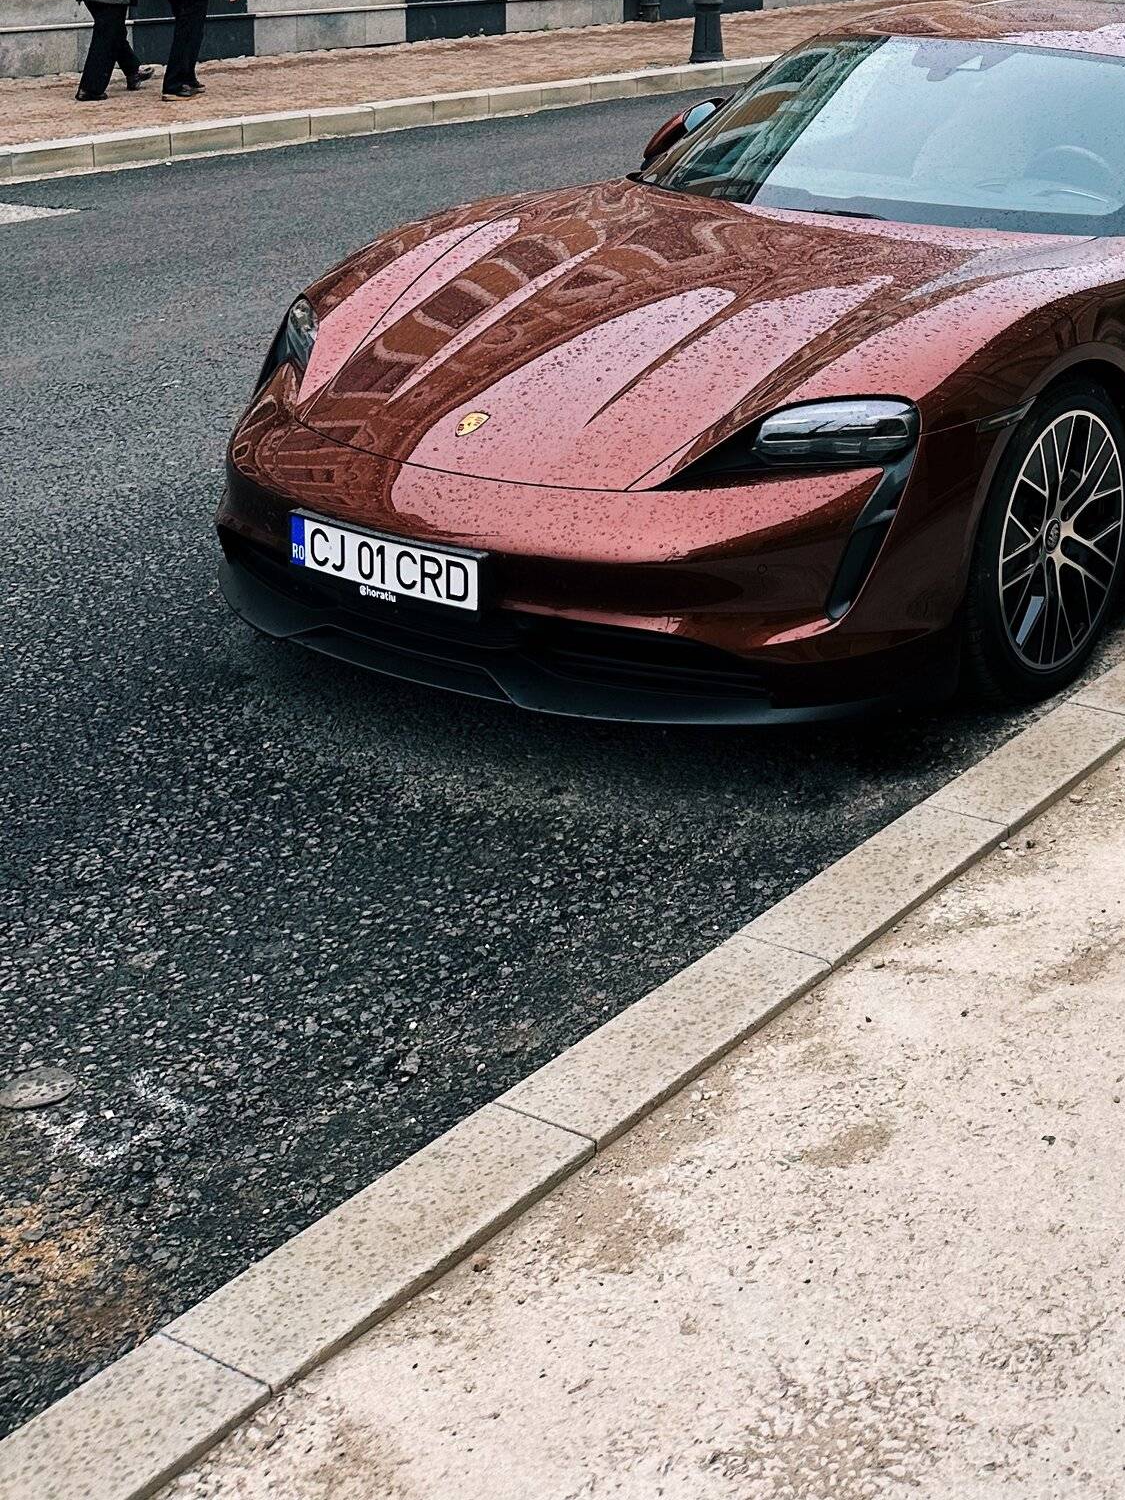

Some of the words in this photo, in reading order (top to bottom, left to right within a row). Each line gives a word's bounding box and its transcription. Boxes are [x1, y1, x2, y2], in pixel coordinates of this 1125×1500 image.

[292, 543, 305, 560] RO
[310, 528, 345, 572] CJ
[358, 541, 386, 584] 01
[396, 550, 469, 602] CRD
